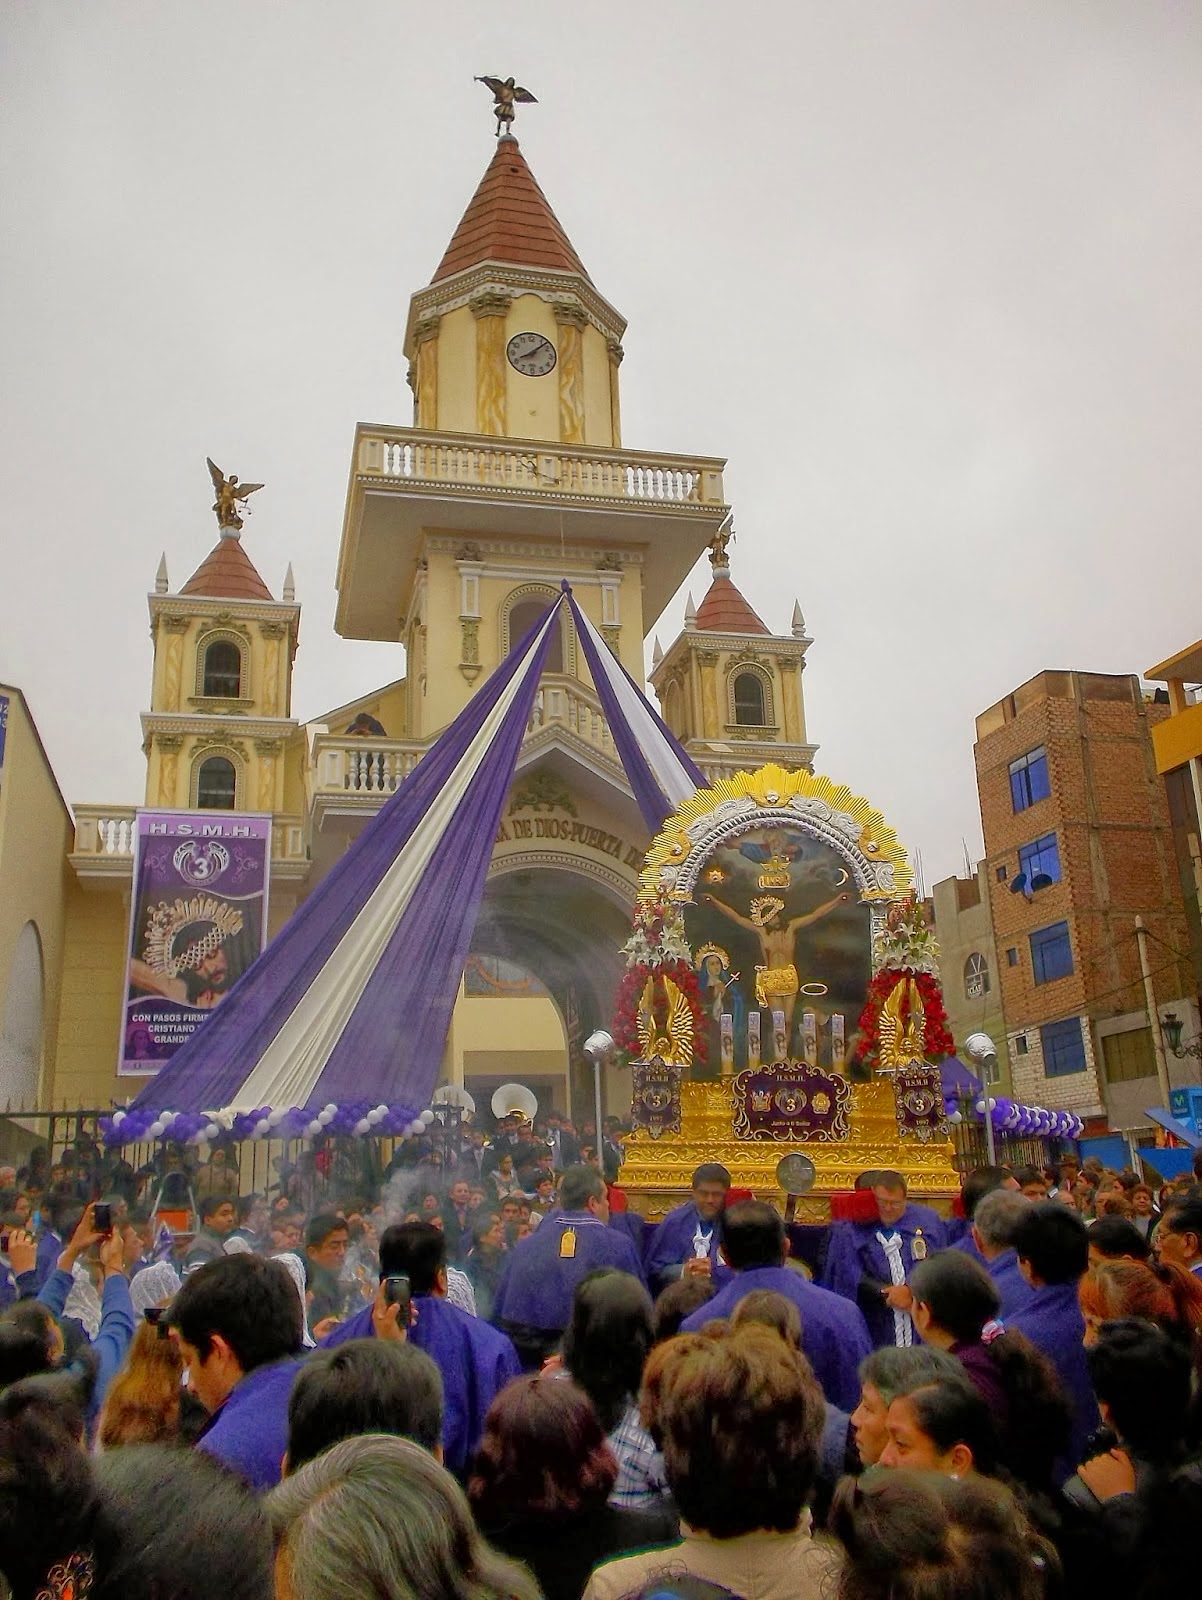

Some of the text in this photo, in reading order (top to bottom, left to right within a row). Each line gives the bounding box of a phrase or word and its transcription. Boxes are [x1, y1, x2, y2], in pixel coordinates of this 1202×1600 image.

[149, 823, 258, 837] H.S.M.H.
[512, 819, 533, 840] DE
[193, 857, 209, 879] 3
[132, 1014, 151, 1022] CON
[153, 1014, 181, 1022] PASOS
[148, 1024, 195, 1033] CRISTIANO
[652, 1095, 661, 1108] 3
[786, 1098, 796, 1112] 3
[915, 1099, 925, 1112] 3
